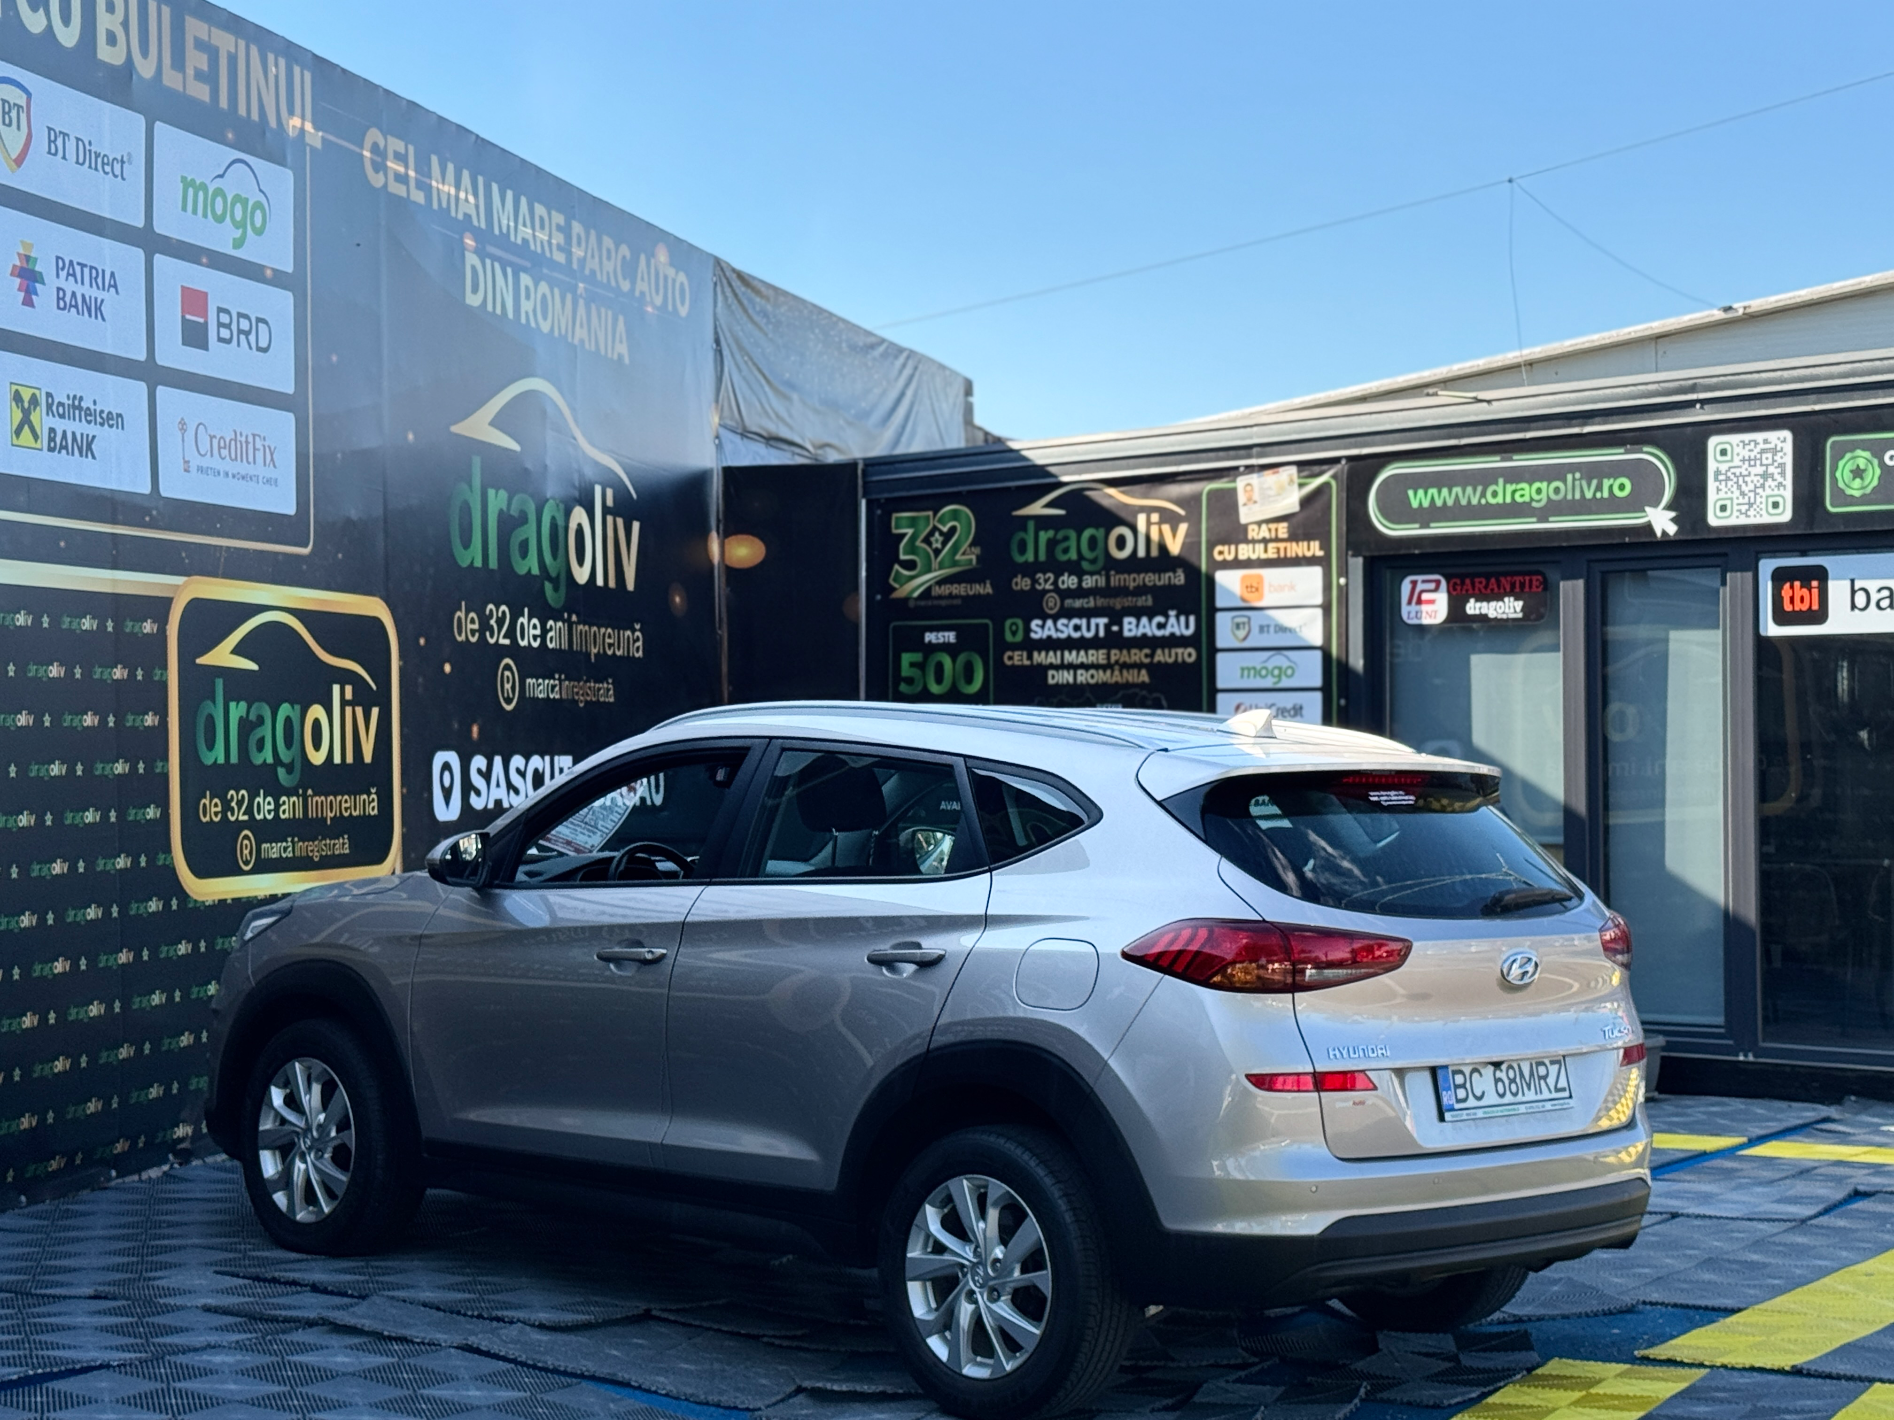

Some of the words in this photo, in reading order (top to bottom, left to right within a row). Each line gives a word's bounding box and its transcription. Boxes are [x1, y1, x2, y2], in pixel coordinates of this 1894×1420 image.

[96, 0, 323, 149] BULETINUL
[0, 97, 24, 132] BT
[45, 125, 71, 161] BT
[180, 174, 267, 250] mogo
[362, 127, 425, 205] CEL
[430, 154, 487, 230] MAI
[491, 182, 566, 264] MARE
[571, 220, 631, 293] PARC
[635, 250, 690, 318] AUTO
[55, 255, 120, 296] PATRIA
[56, 286, 106, 323] BANK
[465, 250, 514, 319] DIN
[519, 276, 630, 364] ROMÂNIA
[216, 306, 272, 354] BRD
[45, 391, 125, 431] Raiffeisen
[47, 427, 97, 460] BANK
[194, 422, 277, 469] CreditFix
[1407, 471, 1633, 509] www.dragoliv.ro
[450, 455, 640, 608] dragoliv
[889, 504, 976, 589] 32
[1009, 512, 1189, 571] dragoliv
[1247, 522, 1288, 540] RATE
[1213, 544, 1236, 561] CU
[1237, 540, 1325, 559] BULETINUL
[1011, 574, 1032, 591] de
[1035, 573, 1055, 590] 32
[1058, 572, 1079, 588] de
[1082, 571, 1106, 588] ani
[1110, 568, 1185, 590] împreună
[1245, 581, 1259, 594] tbi
[1268, 581, 1297, 593] bank
[1406, 579, 1442, 606] 12
[1449, 575, 1544, 595] GARANTIE
[1781, 580, 1820, 612] tbi
[1030, 617, 1108, 639] SASCUT
[1123, 609, 1196, 637] BACĂU
[1407, 610, 1438, 621] LUNI
[1465, 596, 1524, 618] dragoliv
[453, 601, 480, 643] de
[485, 603, 511, 645] 32
[516, 607, 541, 648] de
[546, 612, 569, 650] ani
[572, 613, 644, 662] împreună
[923, 631, 957, 644] PESTE
[1258, 624, 1271, 634] BT
[898, 651, 984, 695] 500
[1003, 651, 1032, 665] CEL
[1033, 650, 1062, 665] MAI
[1064, 650, 1108, 665] MARE
[1110, 649, 1151, 664] PARC
[1153, 648, 1197, 663] AUTO
[525, 673, 560, 699] marcă
[1047, 670, 1074, 685] DIN
[1077, 665, 1150, 684] ROMÂNIA
[1239, 665, 1296, 685] mogo
[195, 678, 380, 787] dragoliv
[199, 790, 223, 823] de
[226, 789, 250, 822] 32
[253, 789, 275, 821] de
[279, 789, 304, 820] ani
[307, 786, 379, 826] împreună
[261, 837, 294, 860] marcă
[1328, 1045, 1391, 1060] HYUNDAI
[1452, 1066, 1486, 1105] BC
[1492, 1059, 1568, 1099] 68MRZ
